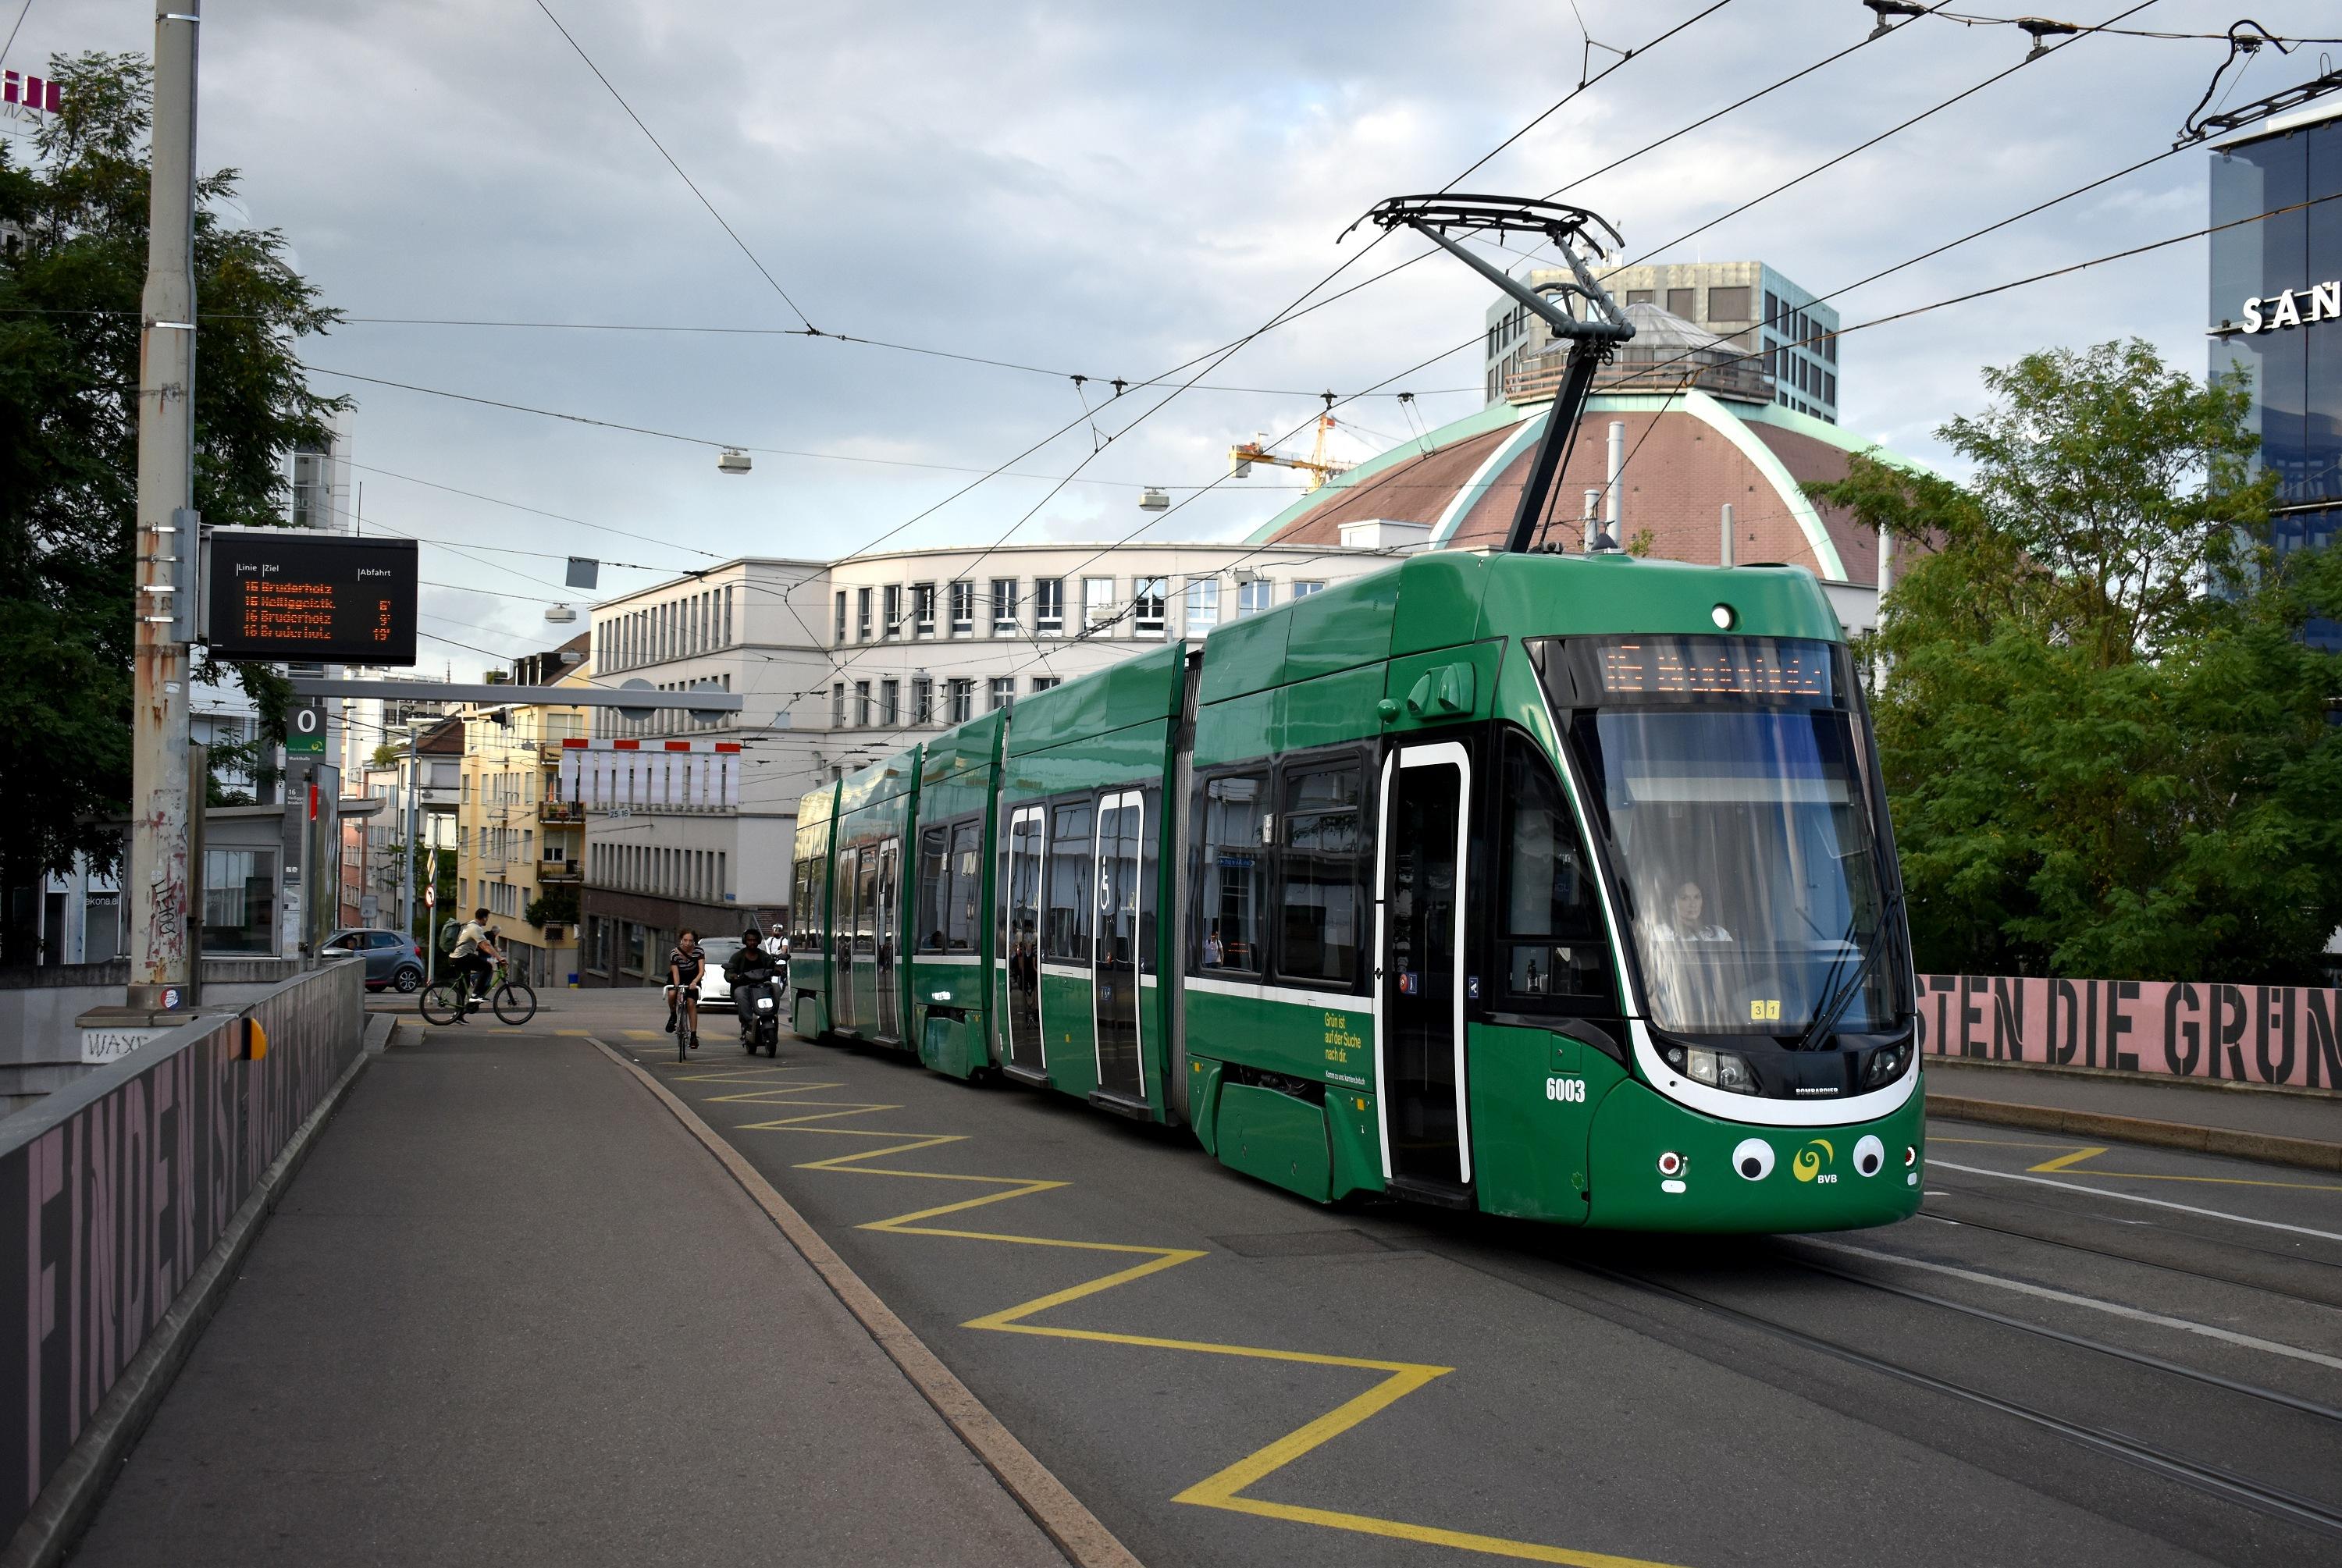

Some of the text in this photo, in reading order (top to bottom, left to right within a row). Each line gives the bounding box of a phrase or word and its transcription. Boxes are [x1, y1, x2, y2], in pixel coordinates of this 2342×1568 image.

[2242, 281, 2341, 334] SAN
[262, 581, 332, 593] Bruderholz
[261, 610, 332, 624] Bruderholz
[261, 624, 331, 638] Bruderholz
[1325, 1012, 1337, 1028] Grün
[2046, 978, 2140, 1071] DIE
[1325, 1030, 1361, 1048] auf der Suche
[1325, 1047, 1347, 1062] nach dir.
[1546, 1077, 1586, 1103] 6003
[1817, 1174, 1838, 1184] BVB
[28, 1042, 196, 1509] FINDEN
